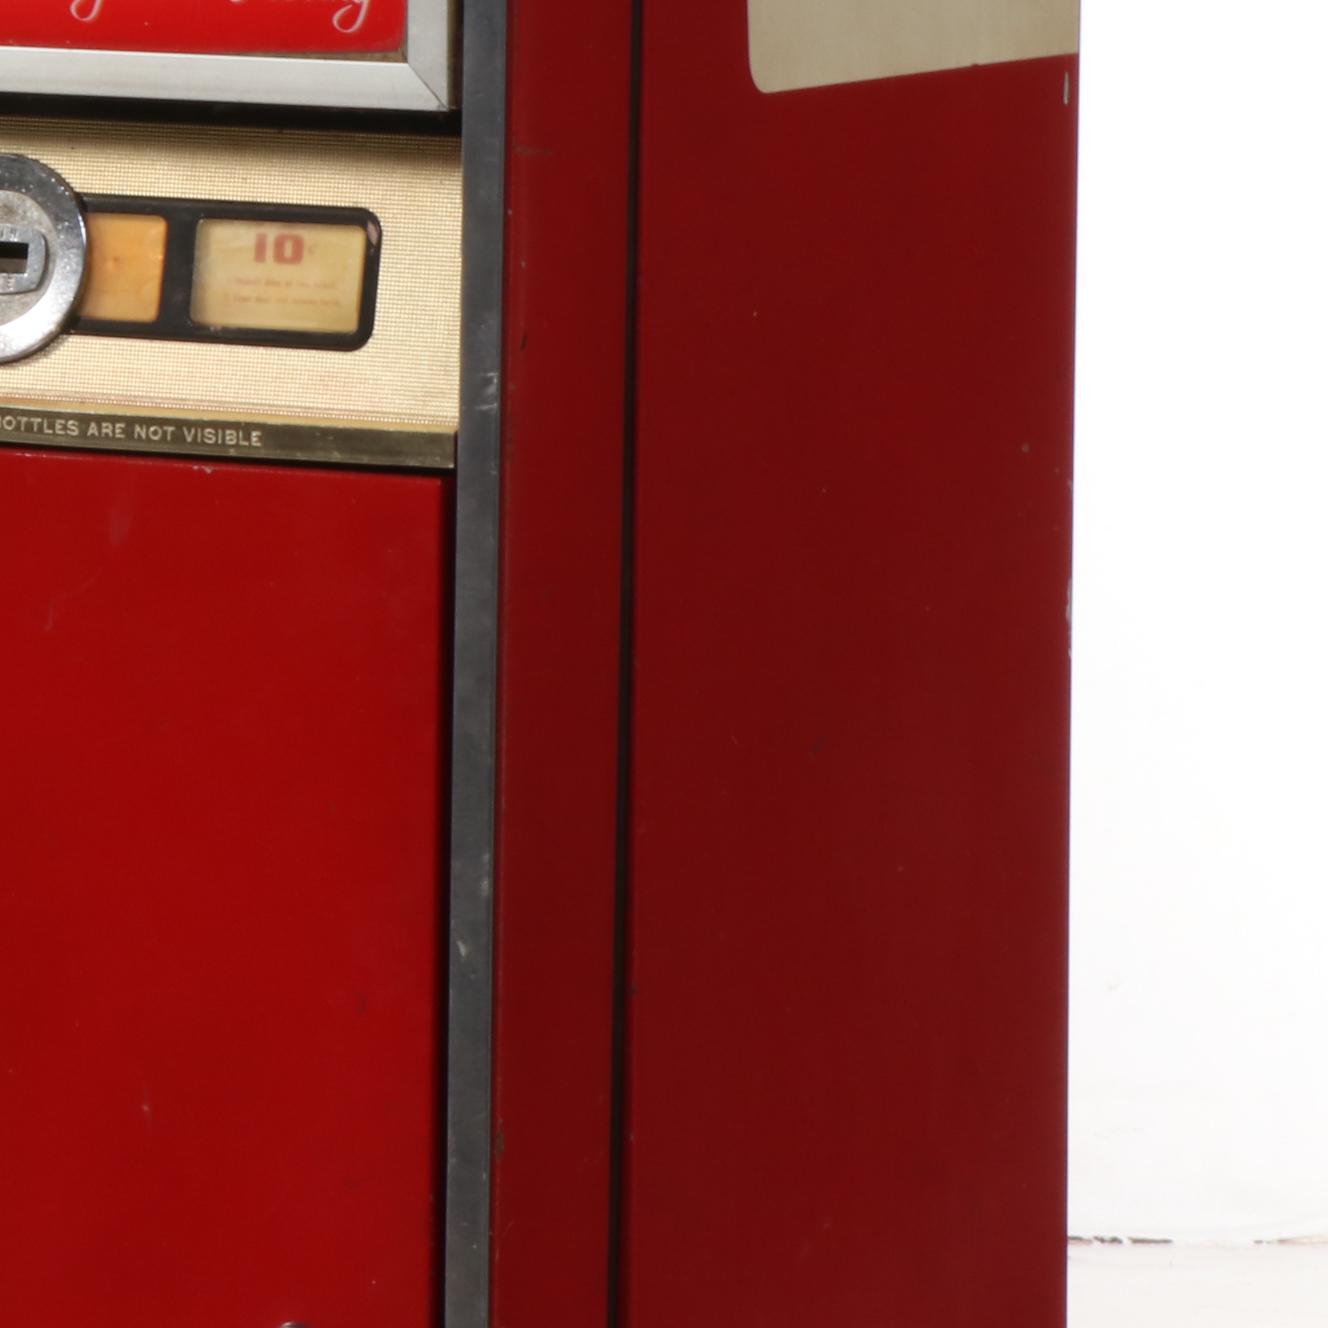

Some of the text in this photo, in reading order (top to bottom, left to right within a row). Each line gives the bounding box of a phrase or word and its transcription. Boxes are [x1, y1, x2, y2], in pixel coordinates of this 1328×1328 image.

[87, 422, 126, 439] ARE
[133, 425, 176, 442] NOT
[183, 427, 263, 447] VISIBLE
